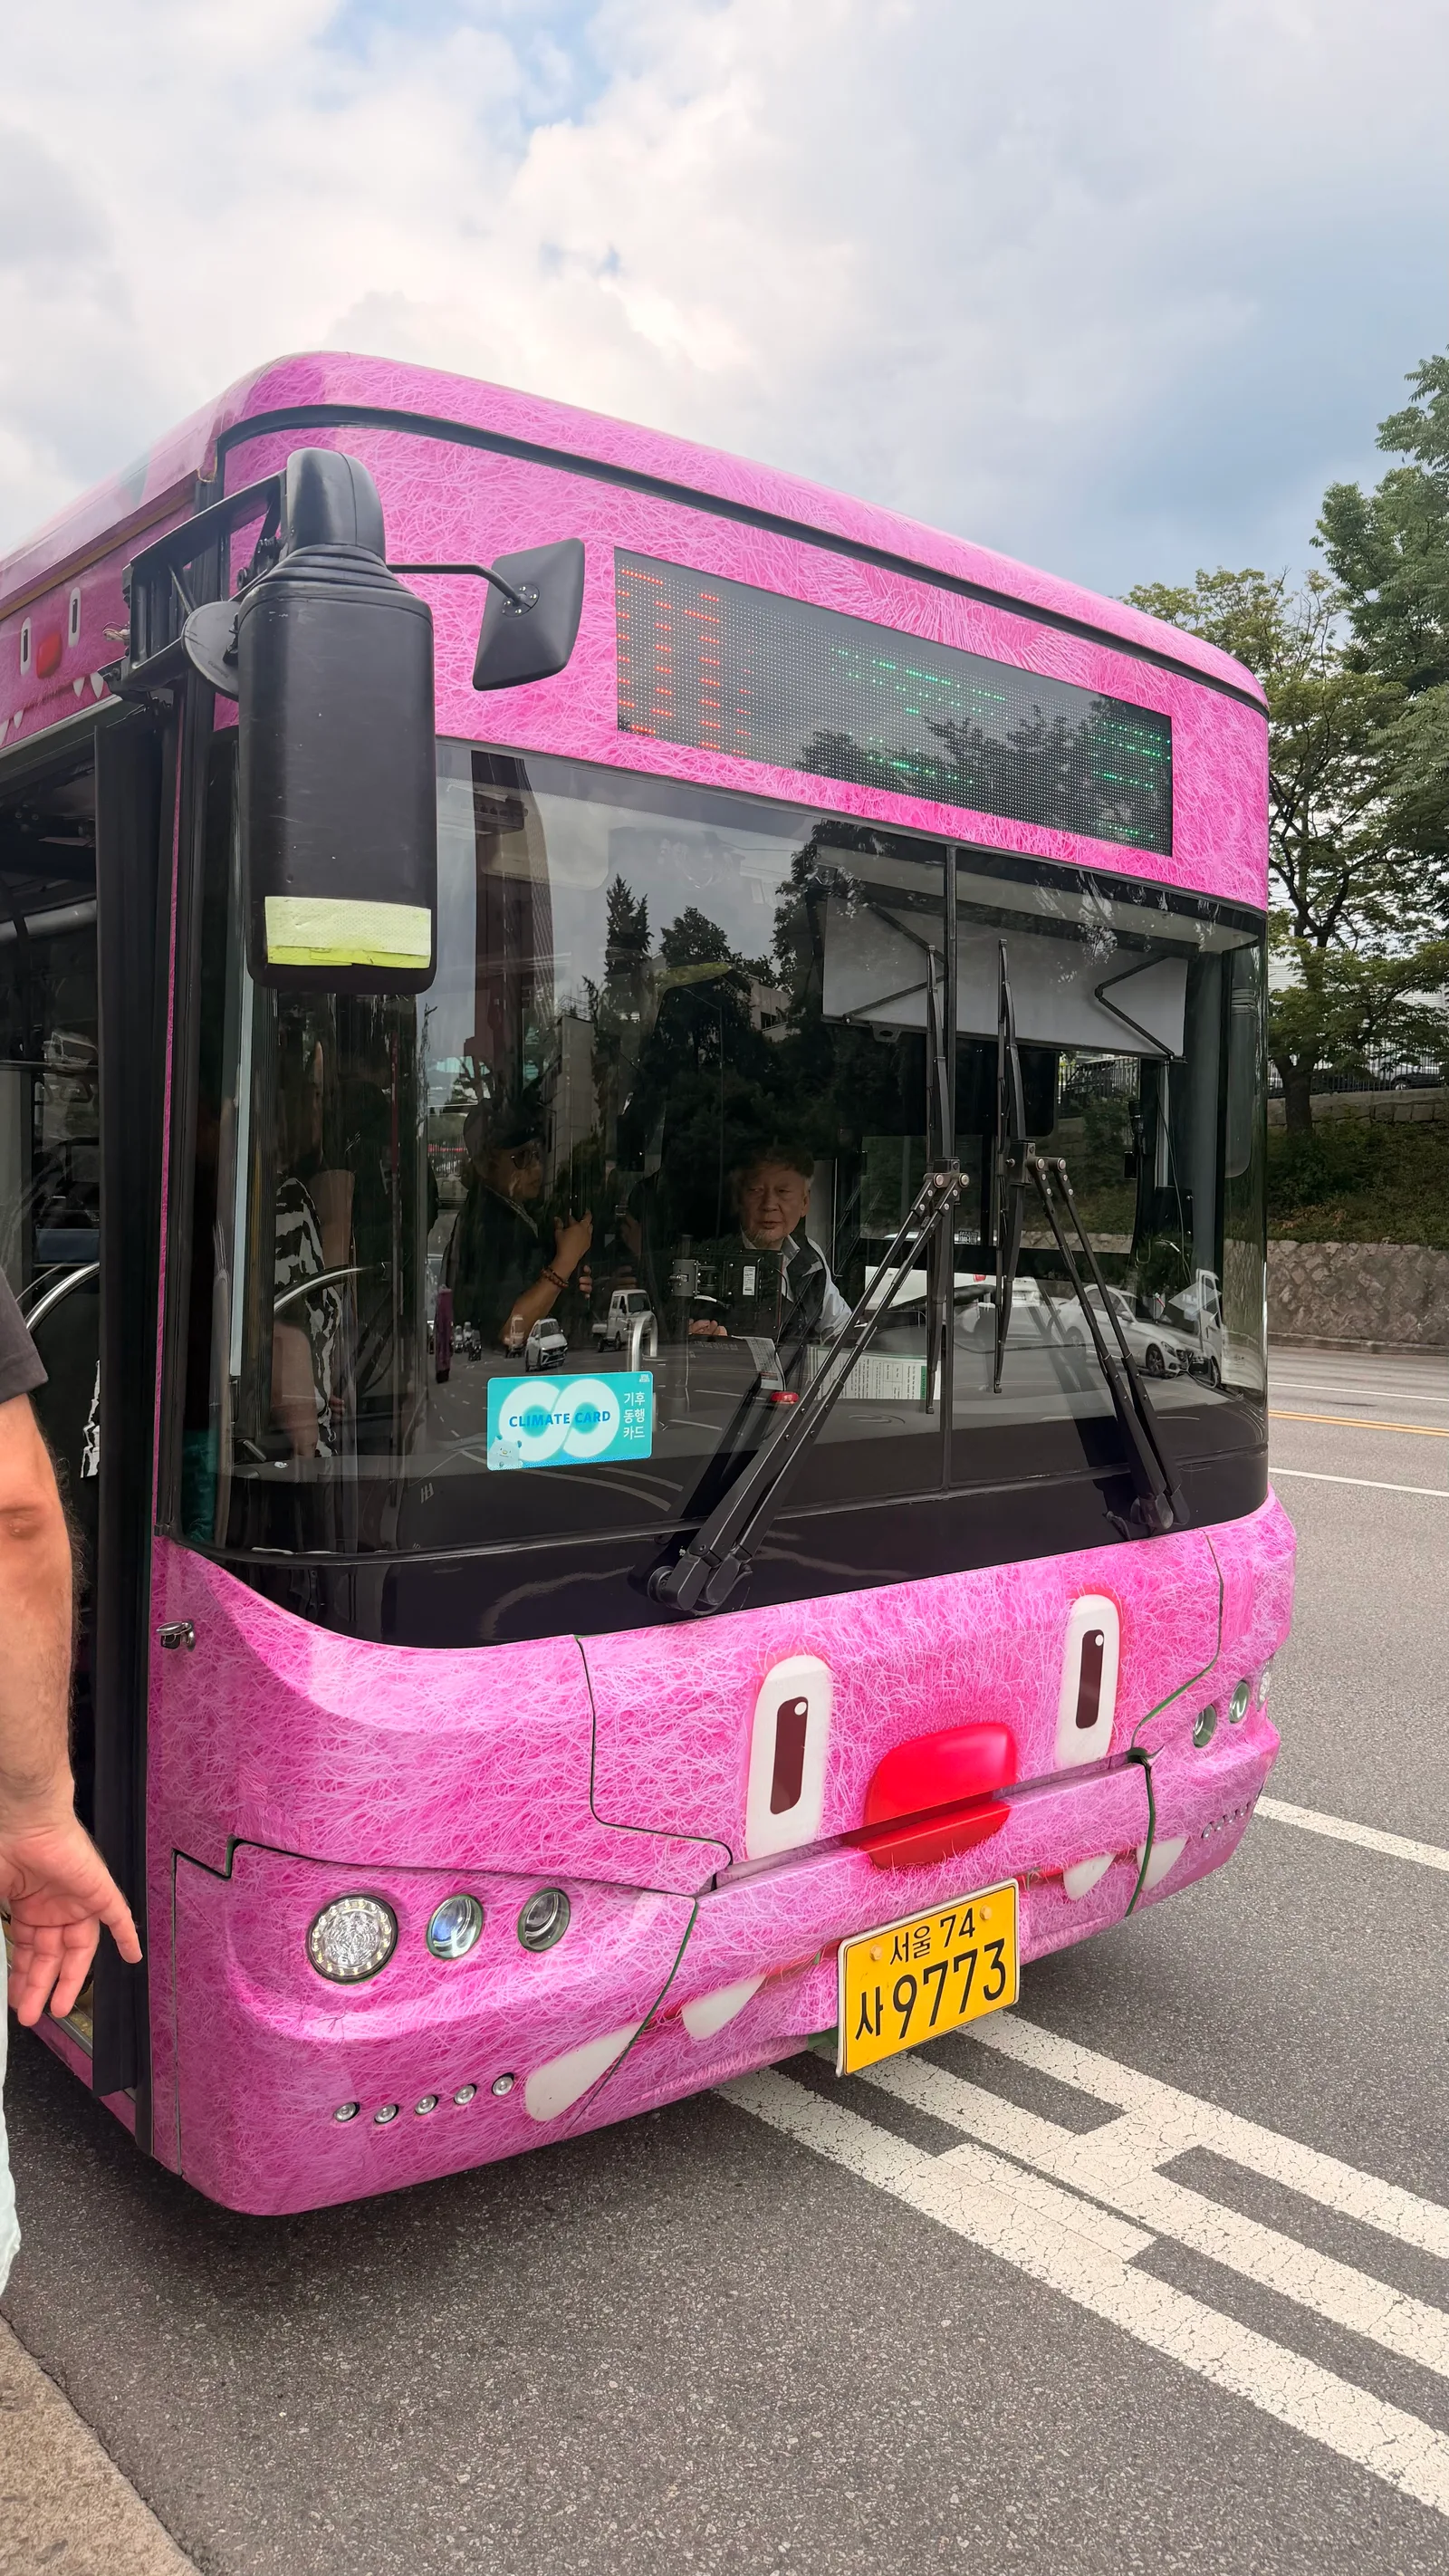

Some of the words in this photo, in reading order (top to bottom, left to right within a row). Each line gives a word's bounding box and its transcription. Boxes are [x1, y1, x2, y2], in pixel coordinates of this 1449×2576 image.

[623, 1391, 646, 1407] 기후
[509, 1413, 571, 1427] CLIMATE
[574, 1410, 611, 1424] CARD
[623, 1408, 646, 1425] 동행
[623, 1427, 646, 1441] 카드
[889, 1925, 931, 1966] 서울
[940, 1908, 976, 1948] 74
[855, 1937, 1006, 2041] 사9773
